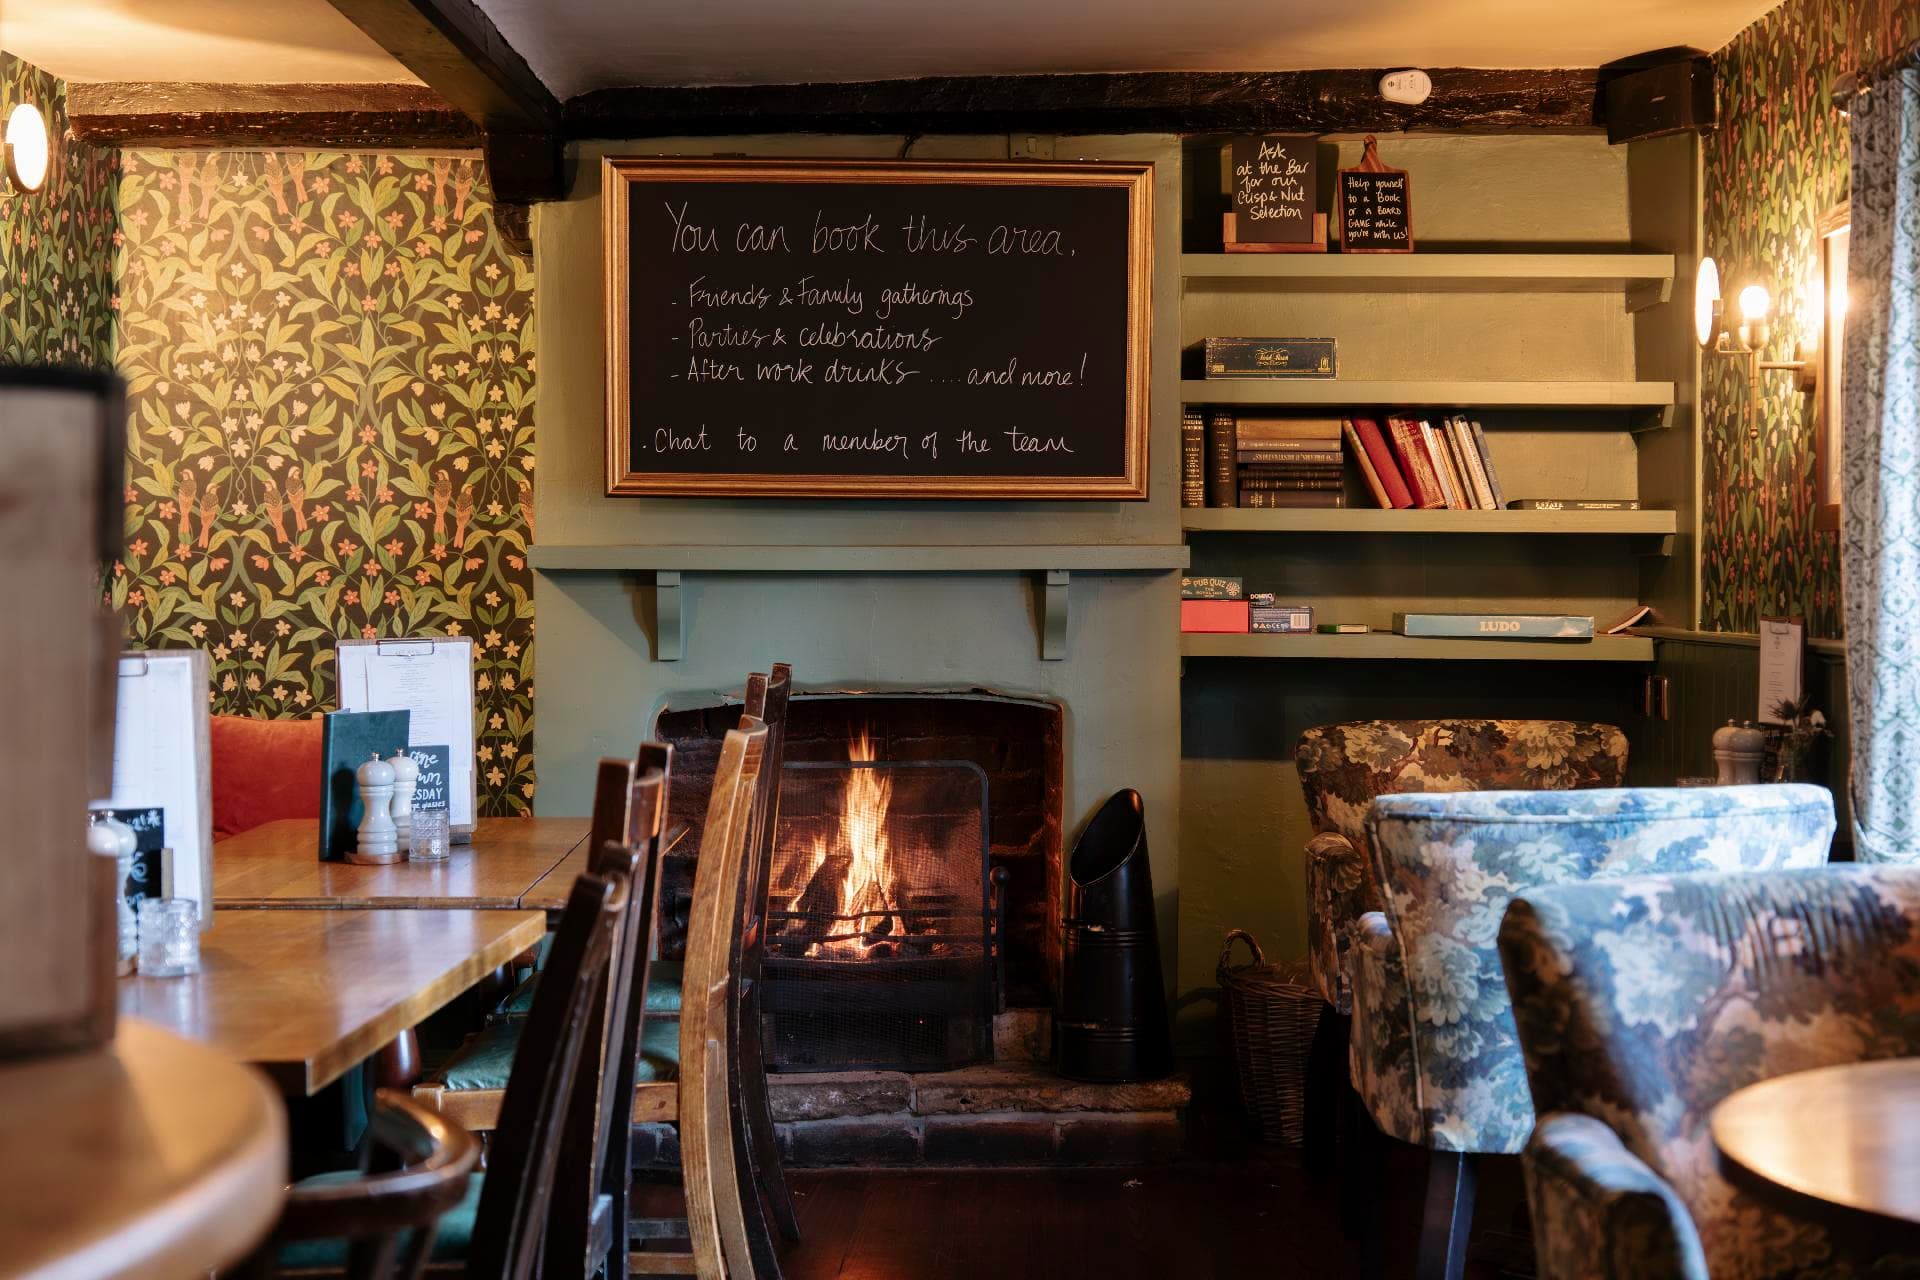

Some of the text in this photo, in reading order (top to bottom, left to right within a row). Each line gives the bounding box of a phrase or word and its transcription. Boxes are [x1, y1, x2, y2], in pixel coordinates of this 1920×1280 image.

[1258, 141, 1287, 160] Ask
[1236, 158, 1310, 176] at the Bar
[1240, 175, 1298, 194] for our
[1347, 176, 1404, 192] Help yourself
[1237, 190, 1268, 209] Crisp
[1281, 186, 1306, 202] Nut
[1347, 191, 1401, 203] to a Book
[1250, 204, 1303, 220] Selection
[1348, 207, 1357, 216] or
[664, 201, 720, 254] You
[735, 222, 791, 253] can
[811, 209, 886, 254] book
[901, 214, 978, 254] this
[1348, 218, 1398, 228] GAME while
[1348, 226, 1409, 242] you're with us!
[688, 275, 773, 310] Friends
[778, 287, 795, 306] &
[796, 274, 864, 315] Family
[875, 281, 974, 320] gatherings
[688, 317, 771, 350] Parties
[772, 327, 788, 346] &
[799, 321, 943, 352] celebrations
[687, 356, 745, 383] After
[757, 358, 814, 384] work
[824, 357, 921, 386] drinks
[967, 357, 1017, 386] and
[1021, 351, 1087, 387] more!
[736, 426, 757, 452] to
[784, 433, 799, 452] a
[822, 428, 909, 460] member
[921, 431, 938, 460] of
[956, 429, 992, 453] the
[1003, 426, 1075, 453] team
[1193, 578, 1227, 588] PUB QUIZ
[1479, 621, 1520, 632] LUDO
